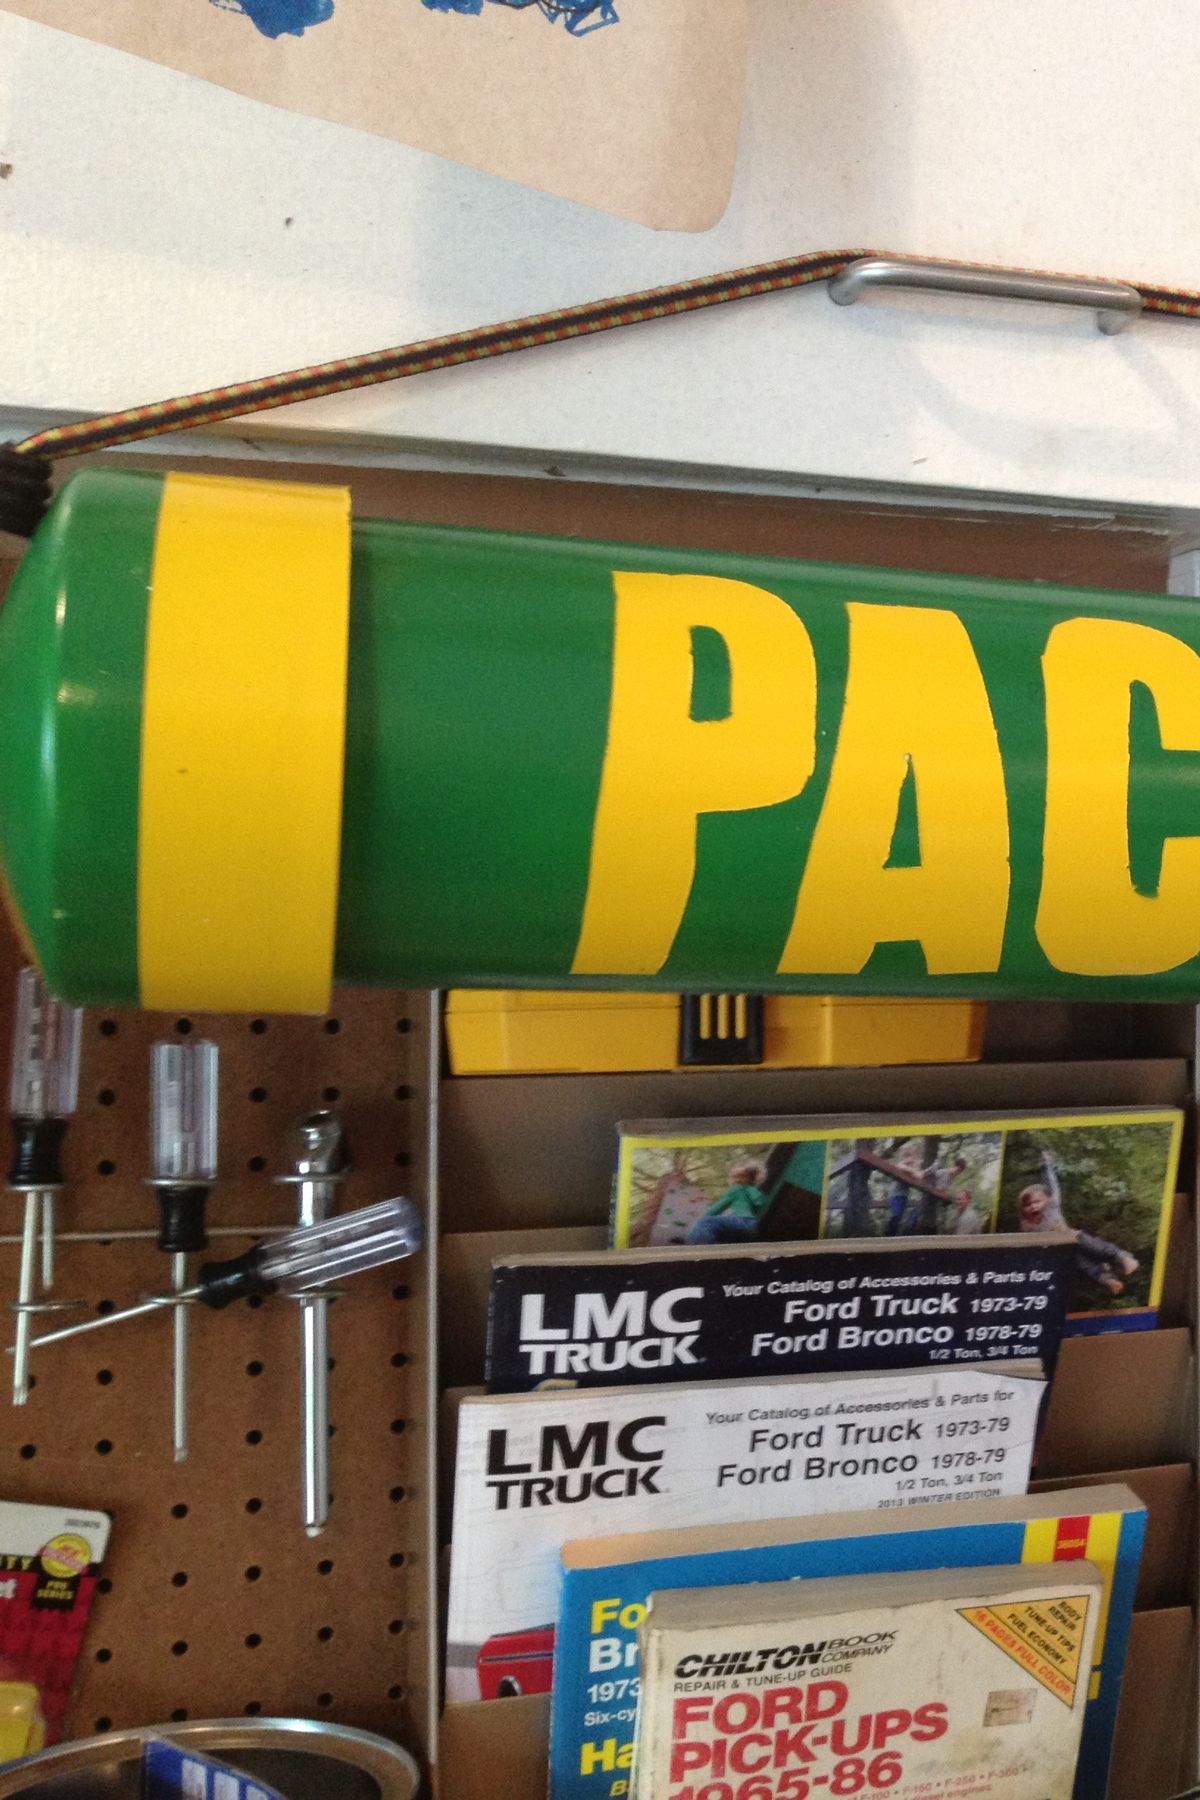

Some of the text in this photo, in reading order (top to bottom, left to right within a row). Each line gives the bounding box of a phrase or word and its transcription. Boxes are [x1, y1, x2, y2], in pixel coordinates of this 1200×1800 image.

[722, 1270, 1054, 1299] Your Catalog of Accessories & Parts for
[519, 1287, 704, 1341] LMC
[783, 1293, 1048, 1324] Ford Truck 1973-79
[519, 1335, 700, 1375] TRUCK
[751, 1323, 1043, 1357] Ford Bronco 1978-79
[929, 1349, 949, 1360] 1/2
[1013, 1345, 1039, 1356] Ton
[706, 1390, 1015, 1425] Your Catalog of Accessories & Parts for
[486, 1416, 666, 1475] LMC
[749, 1417, 1010, 1452] Ford Truck 1973-79
[717, 1448, 1005, 1487] Ford Bronco 1978-79
[896, 1479, 915, 1491] 1/2
[953, 1474, 974, 1486] 3/4
[979, 1471, 1003, 1483] Ton
[485, 1465, 663, 1510] TRUCK
[907, 1493, 952, 1505] WINTER
[955, 1488, 1000, 1501] EDITION
[1048, 1606, 1077, 1632] REPAIR
[1059, 1600, 1083, 1622] BODY
[1007, 1612, 1068, 1665] FUEL ECONOMY
[1024, 1606, 1076, 1653] TUNE-UP TIPS
[674, 1630, 899, 1679] CHILTON BOOK
[821, 1644, 894, 1663] COMPANY
[986, 1618, 1015, 1649] PAGES
[1016, 1644, 1039, 1669] FULL
[1038, 1664, 1072, 1694] COLOR
[587, 1677, 641, 1703] 1973
[673, 1662, 853, 1693] REPAIR & TUNE-UP GUIDE
[672, 1680, 848, 1740] FORD
[670, 1702, 948, 1784] PICK-UPS
